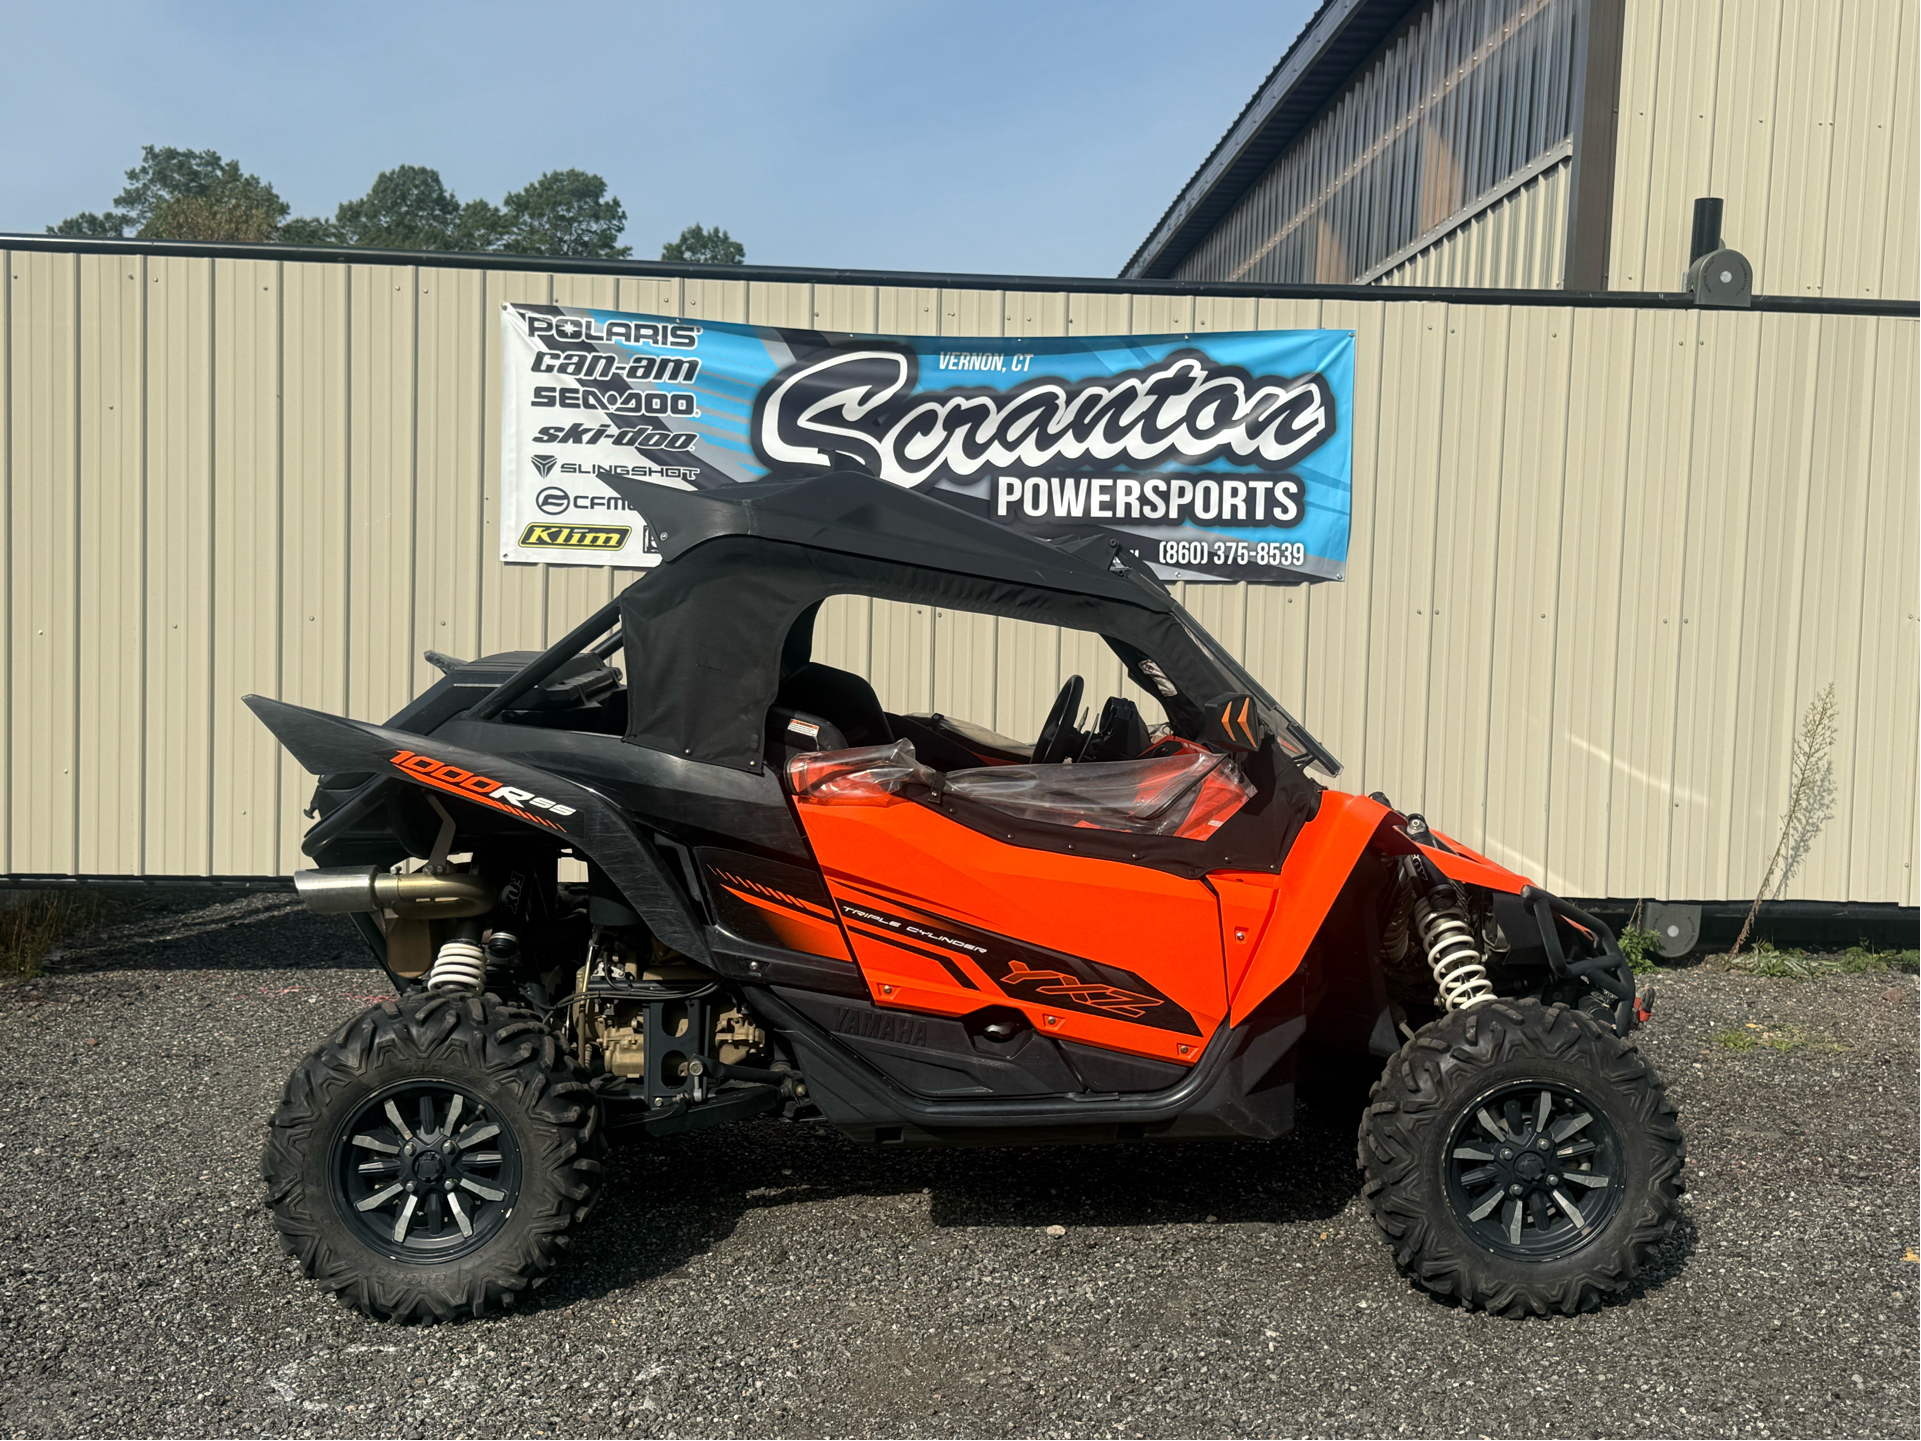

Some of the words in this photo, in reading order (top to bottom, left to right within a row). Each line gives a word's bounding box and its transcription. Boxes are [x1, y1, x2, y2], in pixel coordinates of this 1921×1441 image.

[527, 316, 698, 347] POLARIS
[939, 351, 1007, 374] VERNON,
[1011, 353, 1034, 372] CT
[761, 351, 1327, 489] Scranton
[560, 462, 700, 481] SLINGSHOT
[573, 495, 636, 511] CFM
[998, 476, 1299, 522] POWERSPORTS
[1158, 541, 1208, 565] (860)
[1212, 543, 1305, 567] 375-8539
[843, 905, 902, 928] TRIPLE
[906, 925, 988, 954] CYLINDER
[834, 1004, 927, 1048] YAMAHA
